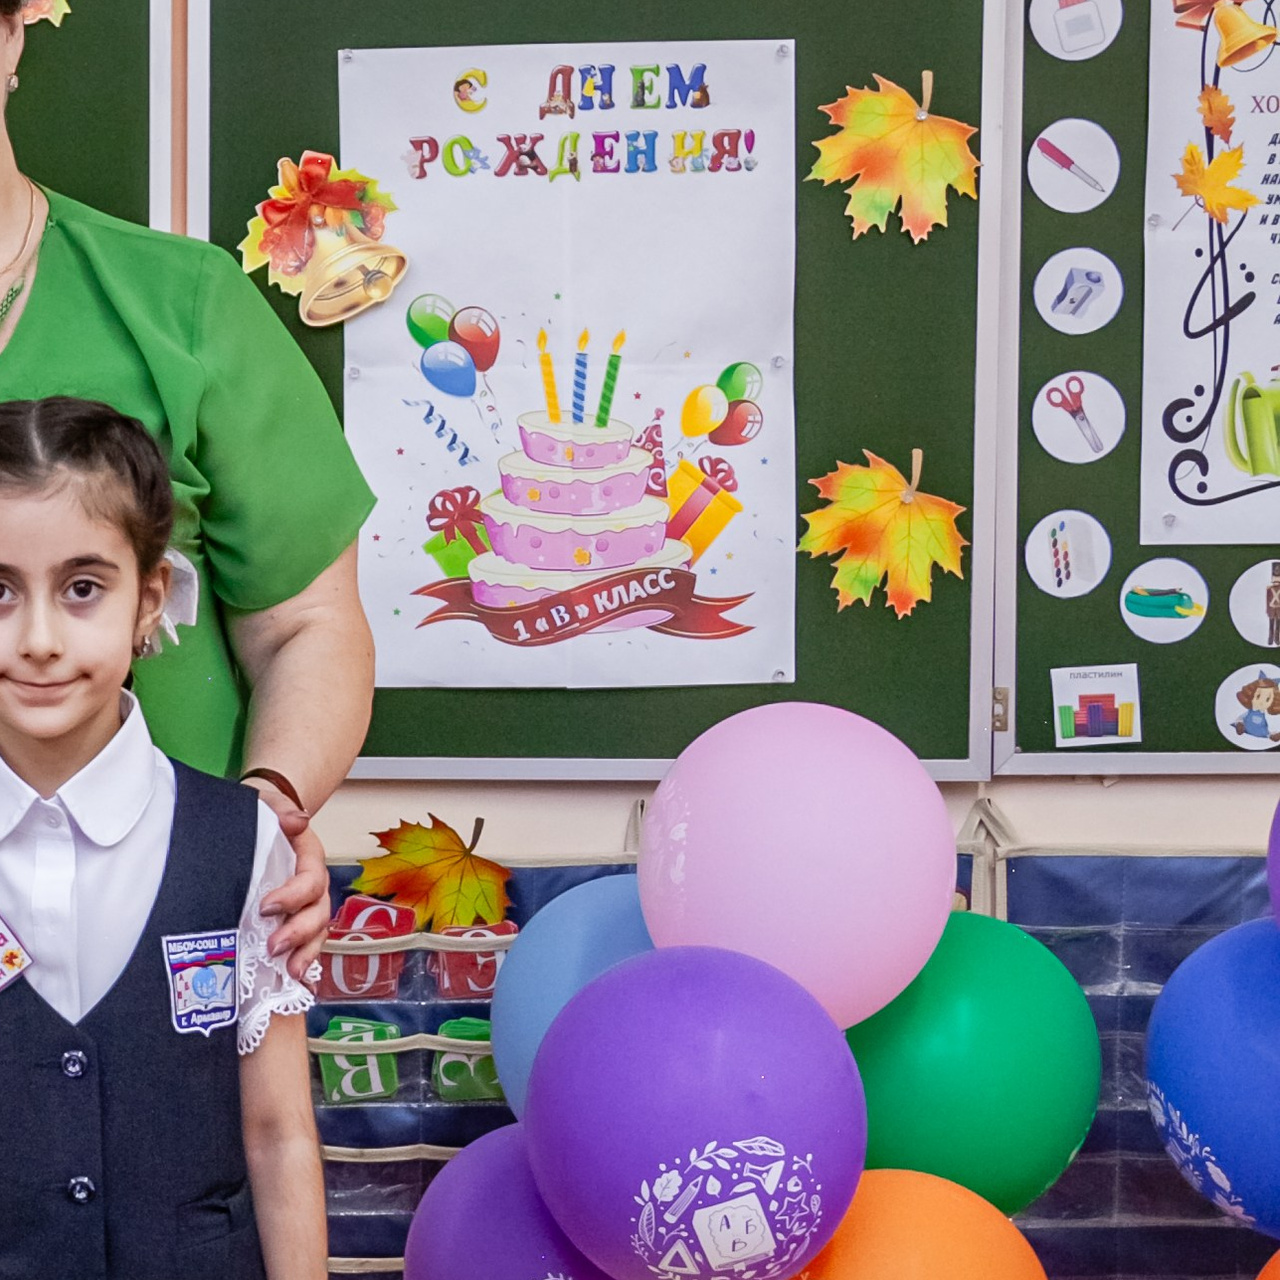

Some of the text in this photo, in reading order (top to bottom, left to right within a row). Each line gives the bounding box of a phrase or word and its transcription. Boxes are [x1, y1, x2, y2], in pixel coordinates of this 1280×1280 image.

[452, 67, 489, 112] С
[514, 620, 530, 642] 1
[593, 569, 676, 614] КЛАСС
[1069, 670, 1123, 681] пластилин
